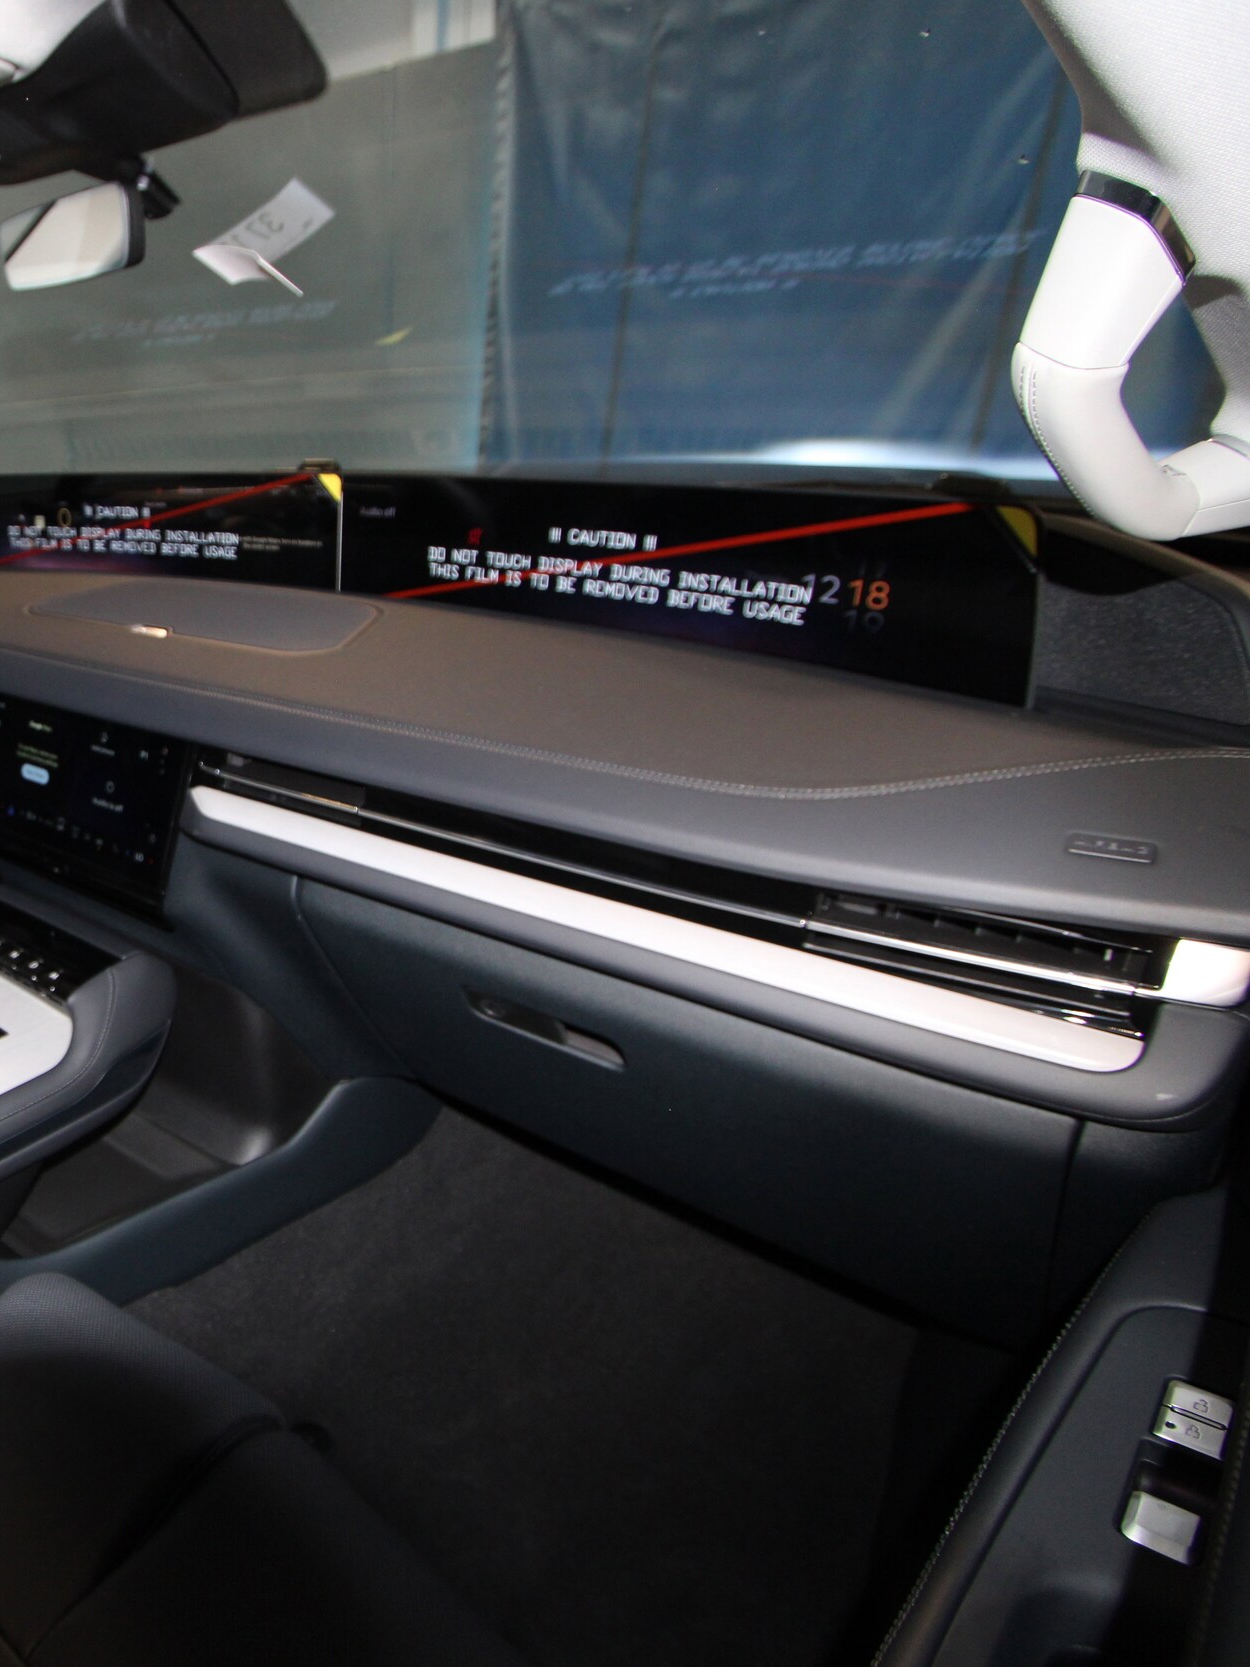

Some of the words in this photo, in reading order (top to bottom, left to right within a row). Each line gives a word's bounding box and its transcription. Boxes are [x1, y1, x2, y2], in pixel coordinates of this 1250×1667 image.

[95, 505, 139, 520] CAUTION
[47, 525, 77, 538] TOUCH
[80, 526, 121, 540] DISPLAY
[124, 528, 162, 541] DURING
[165, 529, 240, 547] INSTALLATION
[567, 528, 637, 550] CAUTION
[77, 539, 90, 552] TO
[93, 540, 107, 553] BE
[109, 540, 157, 555] REMOVED
[160, 542, 200, 558] BEFORE
[203, 546, 238, 560] USAGE
[427, 546, 446, 562] DO
[451, 548, 479, 565] NOT
[485, 551, 532, 570] TOUCH
[537, 555, 603, 578] DISPLAY
[609, 563, 671, 587] DURING
[677, 570, 815, 605] INSTALLATION
[429, 562, 460, 581] THIS
[465, 566, 500, 584] FILM
[505, 569, 523, 587] IS
[529, 572, 550, 591] TO
[555, 576, 577, 595] BE
[582, 578, 660, 605] REMOVED
[666, 588, 736, 616] BEFORE
[742, 600, 807, 626] USAGE
[801, 573, 841, 605] 12
[848, 578, 892, 611] 18
